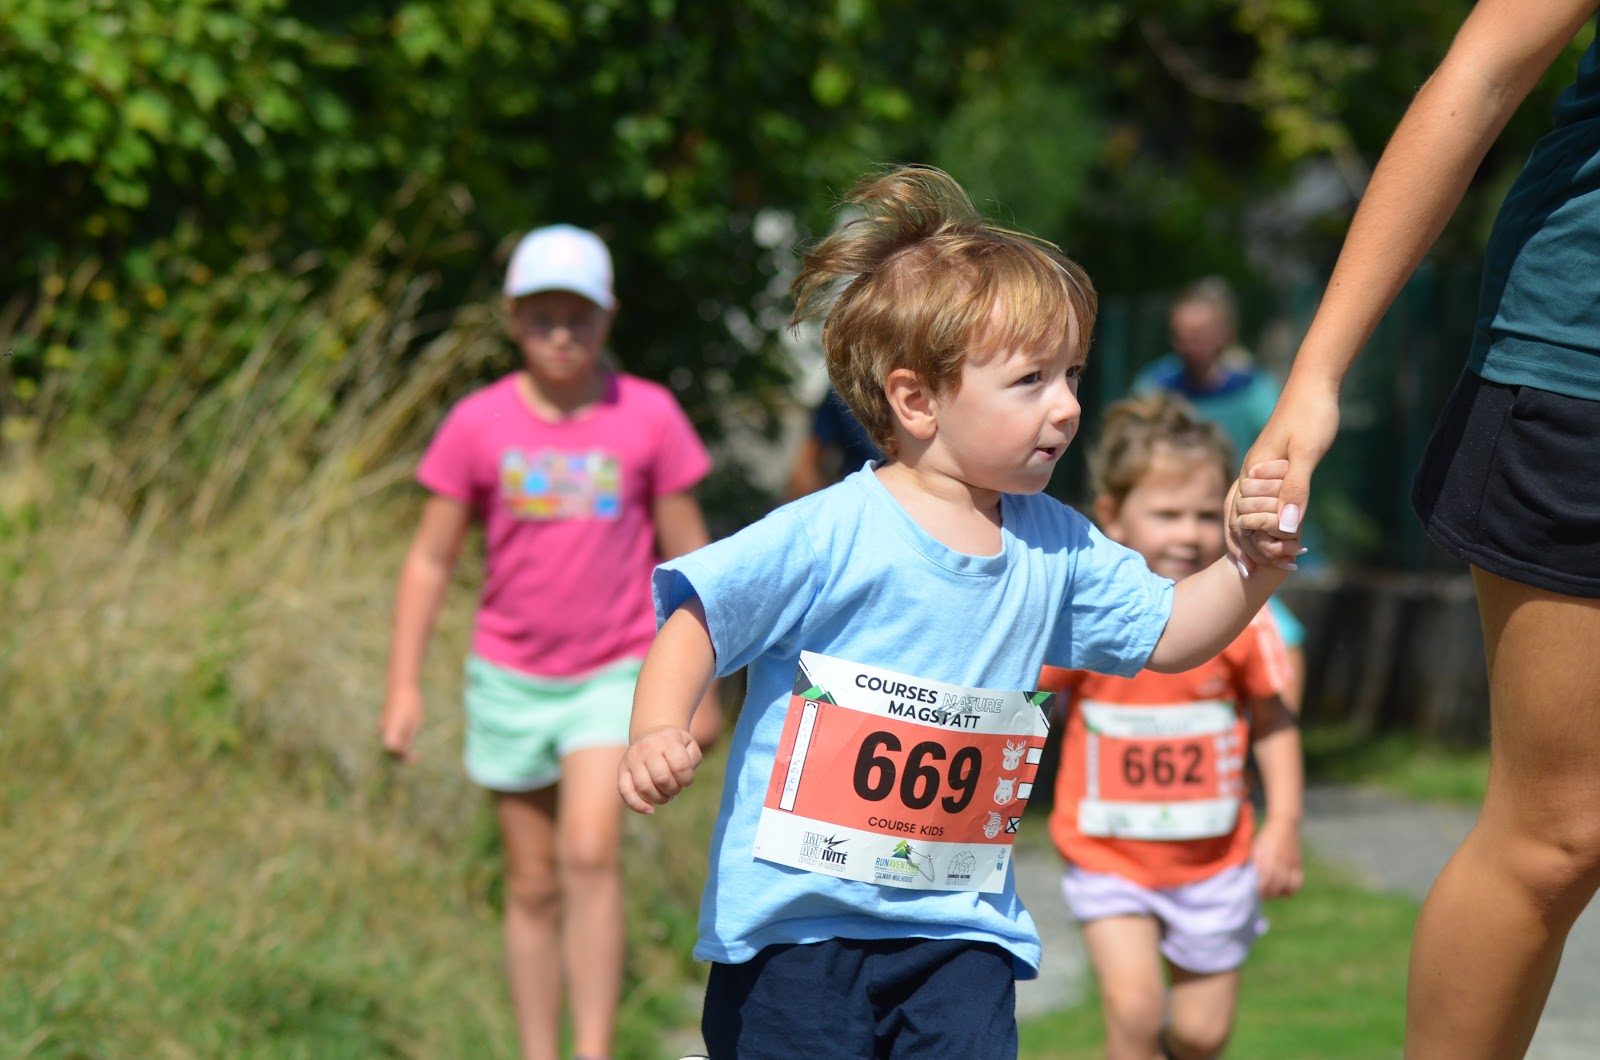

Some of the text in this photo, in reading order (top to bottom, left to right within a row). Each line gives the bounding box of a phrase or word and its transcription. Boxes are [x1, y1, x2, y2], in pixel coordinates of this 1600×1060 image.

[855, 674, 1003, 713] COURSES NATURE
[888, 700, 980, 729] MAGSTATT
[853, 731, 982, 814] 669
[1122, 744, 1204, 787] 662
[868, 817, 944, 836] COURSE KIDS
